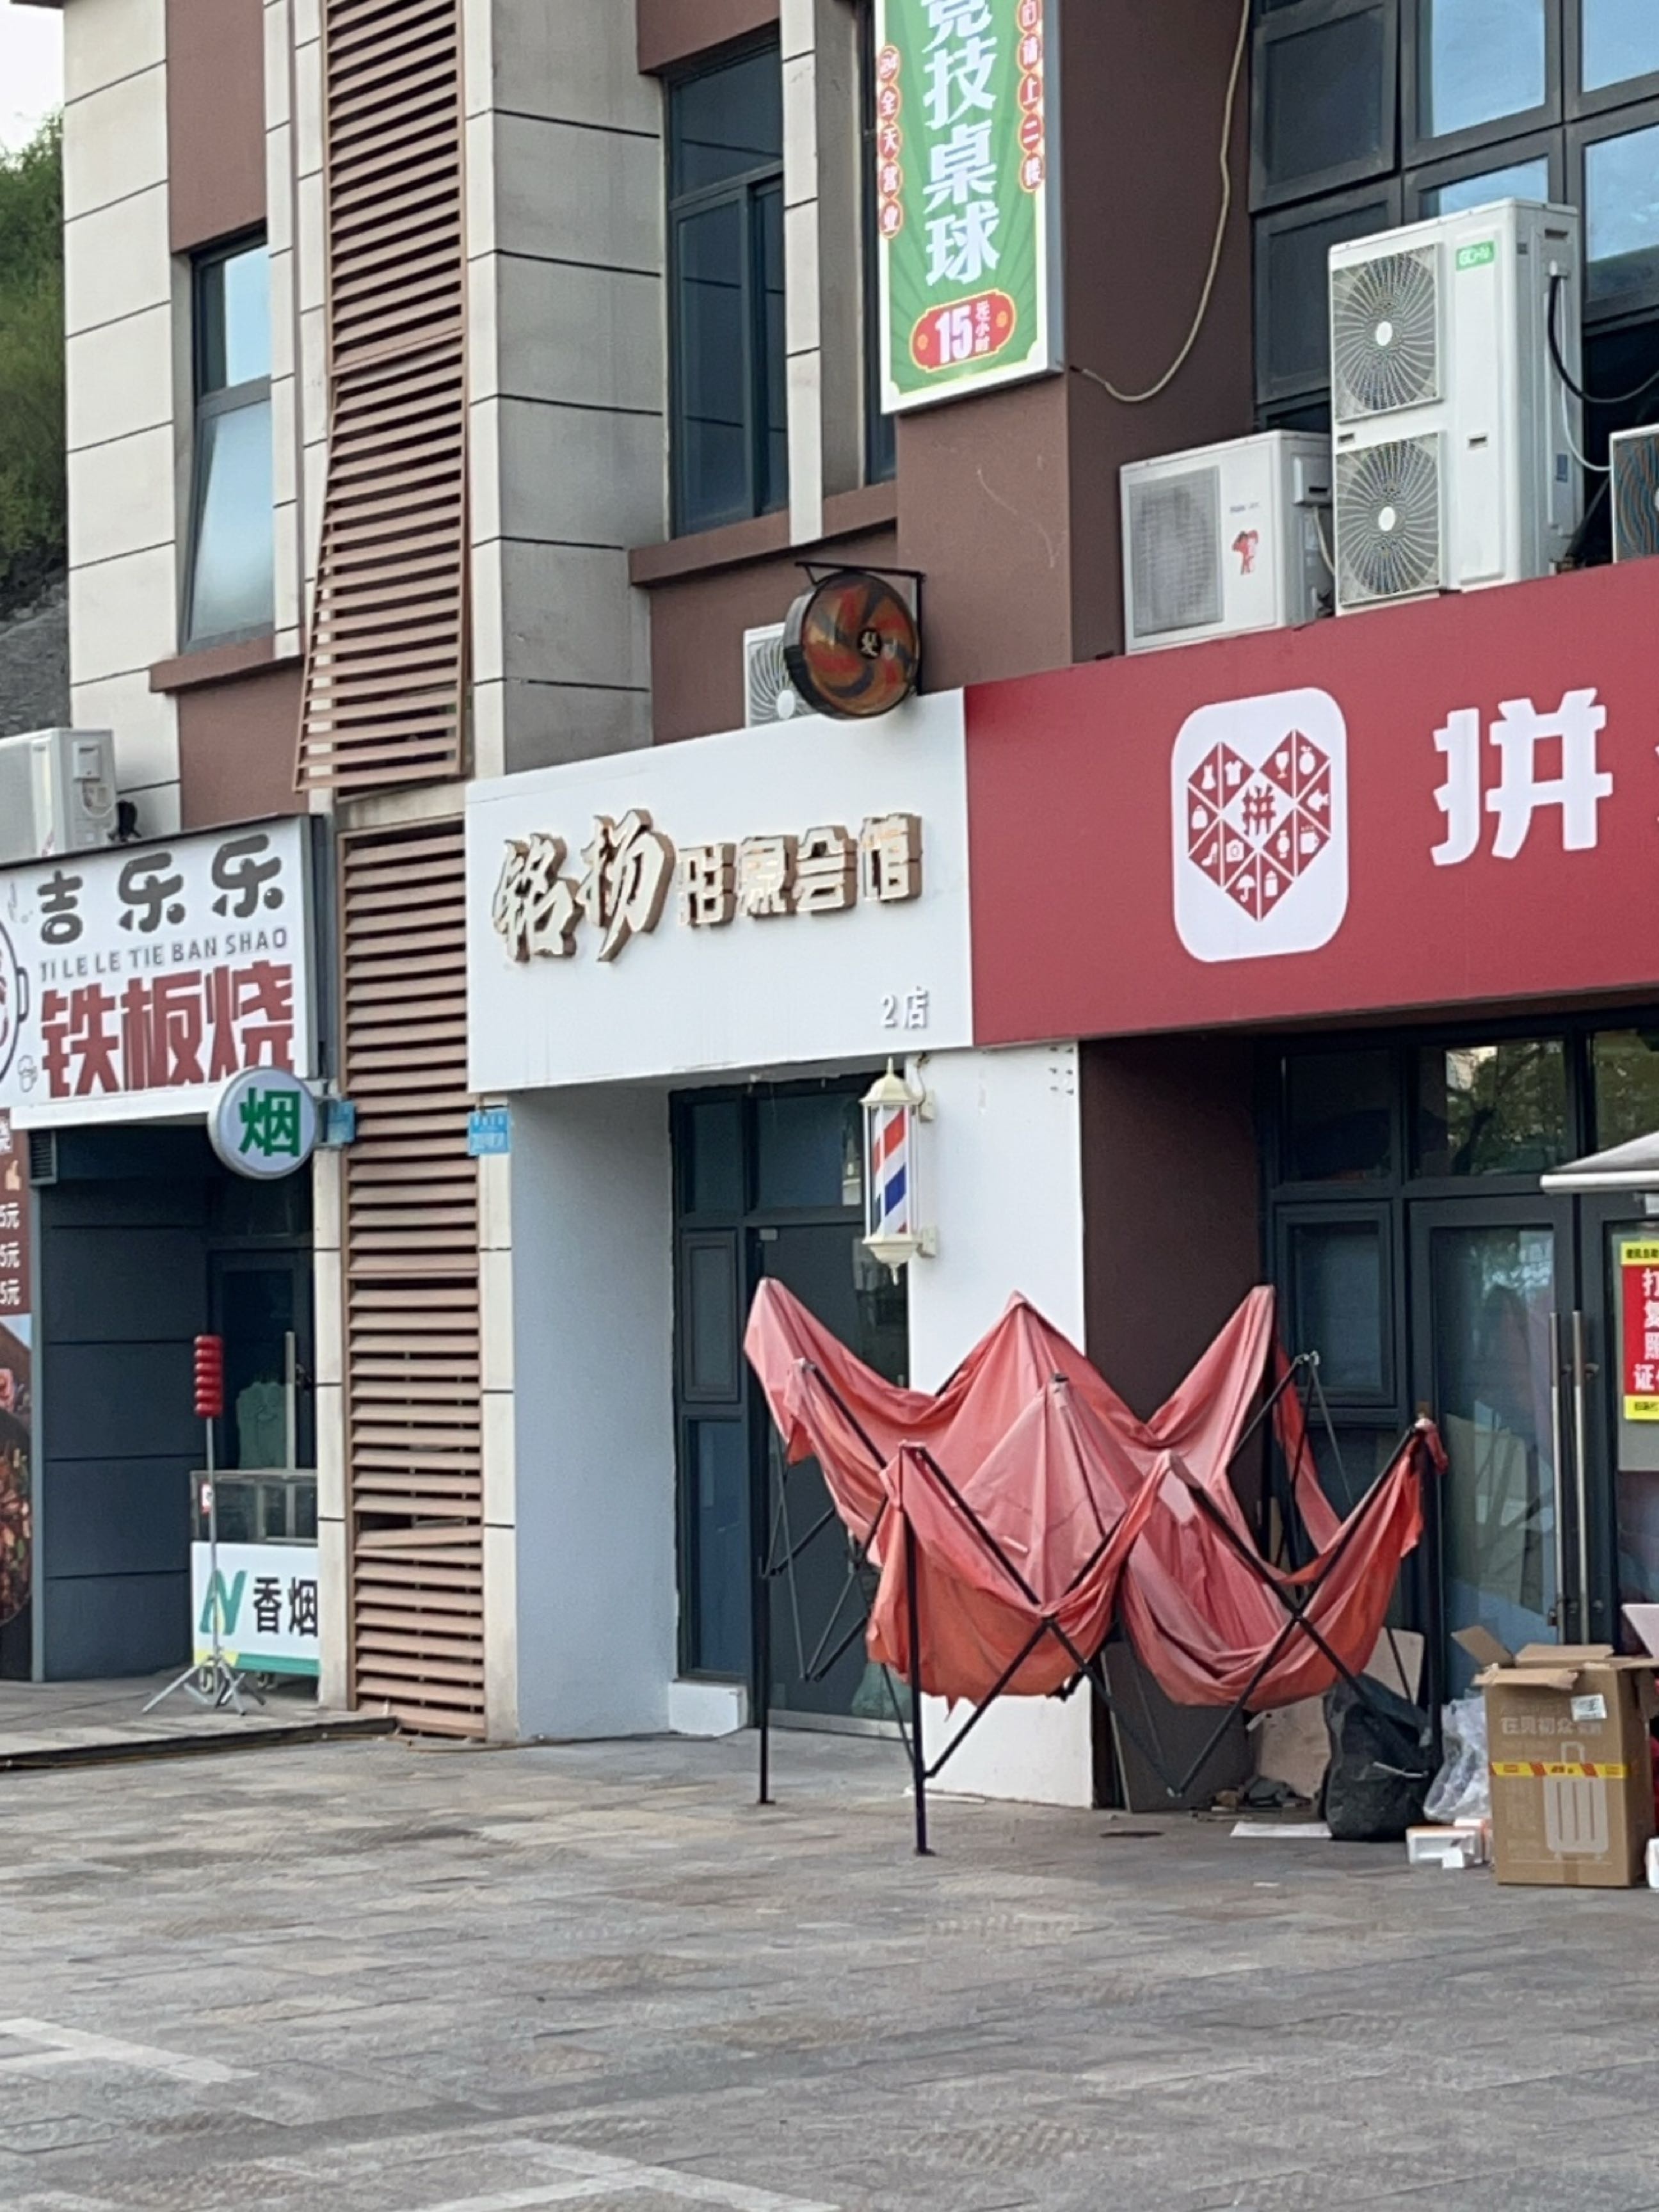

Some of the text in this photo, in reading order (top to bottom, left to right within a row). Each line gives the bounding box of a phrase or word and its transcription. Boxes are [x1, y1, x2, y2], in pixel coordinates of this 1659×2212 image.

[934, 305, 973, 364] 15
[1430, 687, 1659, 866] 拼
[1241, 783, 1276, 837] 拼
[37, 834, 284, 945] 吉乐乐
[63, 956, 88, 979] LE
[95, 950, 120, 974] LE
[129, 944, 164, 968] TIE
[171, 936, 217, 963] BAN
[225, 927, 287, 956] SHAO
[41, 959, 294, 1099] 铁板烧
[880, 985, 929, 1030] 2店
[238, 1087, 300, 1157] 烟
[1633, 1363, 1659, 1391] 证
[253, 1576, 319, 1638] 香烟
